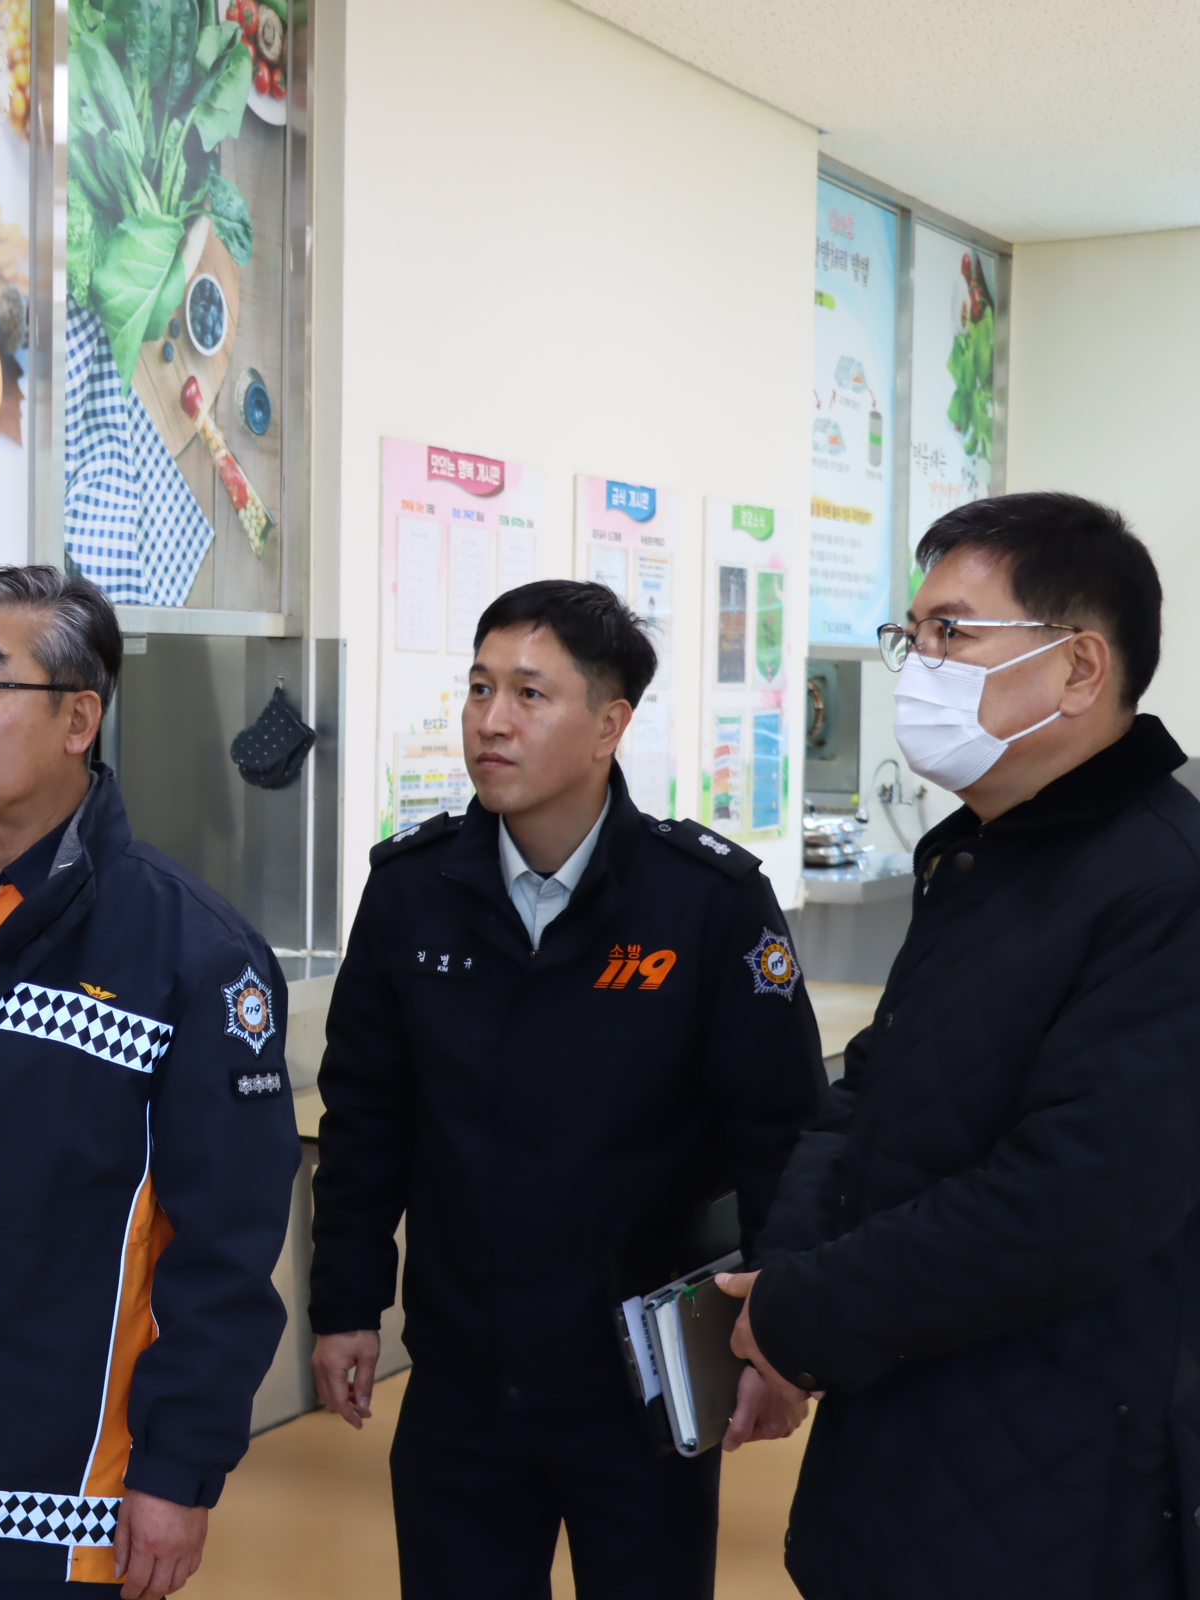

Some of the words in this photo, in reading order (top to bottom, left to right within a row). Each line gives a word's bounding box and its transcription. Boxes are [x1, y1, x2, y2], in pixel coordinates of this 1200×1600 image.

[431, 454, 456, 478] 맛있는
[458, 458, 475, 480] 행복
[476, 463, 500, 485] 게시판
[612, 488, 626, 506] 급식
[628, 490, 649, 510] 게시판
[740, 510, 766, 528] 영양소식
[608, 944, 642, 959] 소방
[593, 949, 677, 990] 119
[771, 955, 784, 972] 119
[244, 1003, 261, 1015] 119
